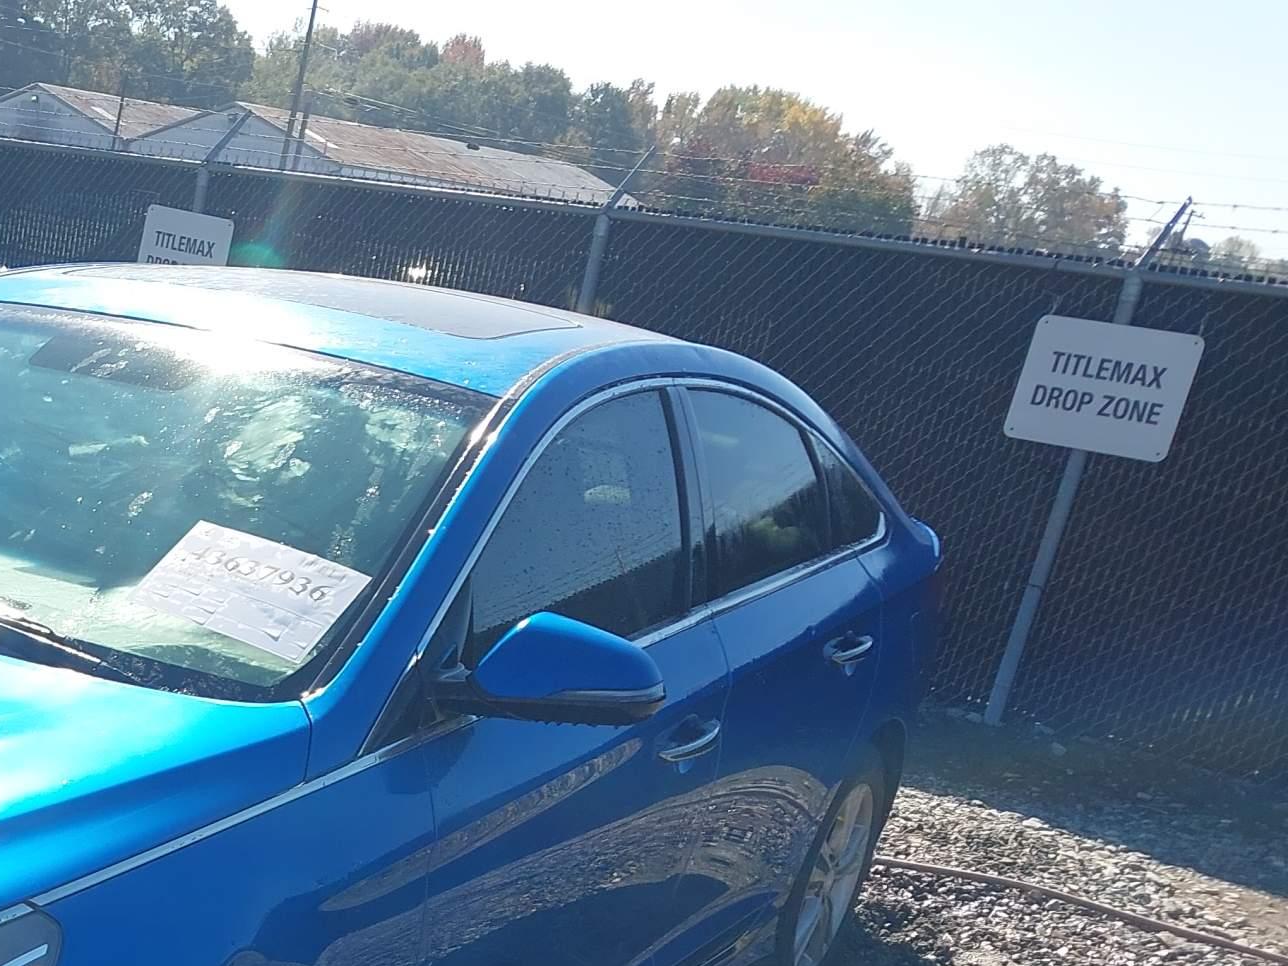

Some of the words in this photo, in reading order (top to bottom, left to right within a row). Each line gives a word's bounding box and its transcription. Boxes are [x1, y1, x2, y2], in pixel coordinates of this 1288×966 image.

[155, 231, 216, 258] TITLEMAX
[1051, 351, 1168, 390] TITLEMAX
[1030, 384, 1094, 413] DROP
[1096, 395, 1164, 425] ZONE
[190, 546, 336, 602] 43637936
